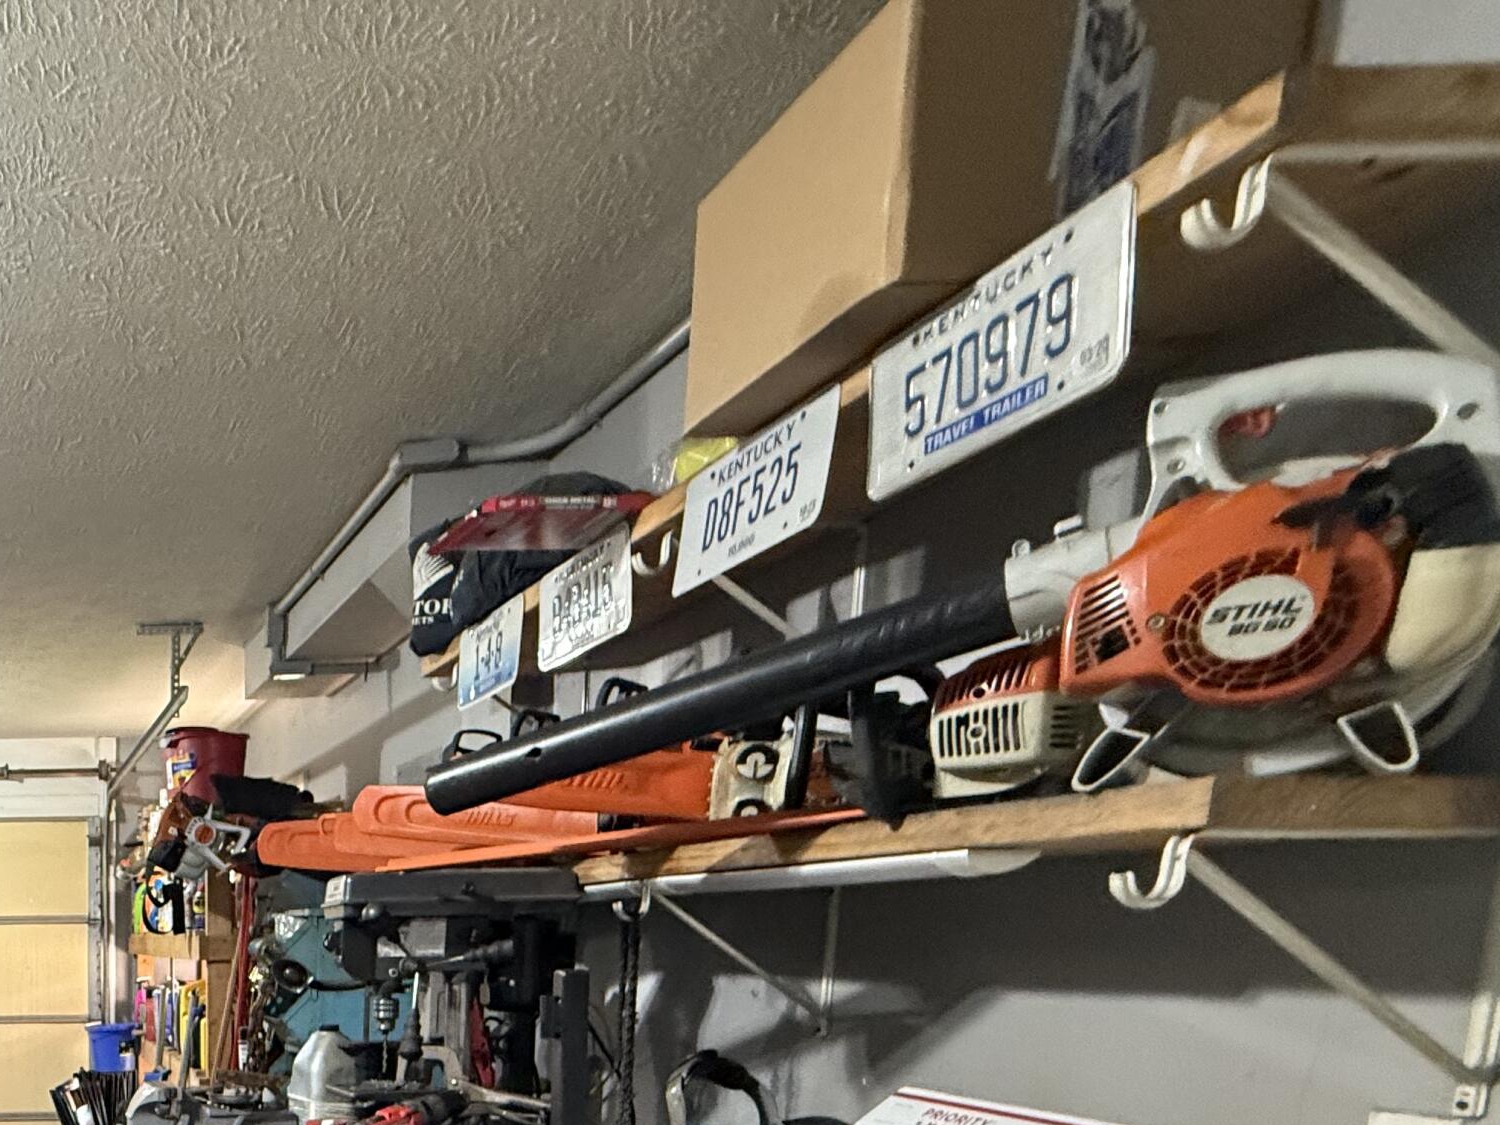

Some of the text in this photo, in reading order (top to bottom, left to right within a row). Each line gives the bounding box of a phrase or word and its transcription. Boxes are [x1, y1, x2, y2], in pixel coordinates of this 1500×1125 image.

[921, 243, 1054, 346] KENTUCKY
[904, 273, 1075, 437] 570979
[982, 379, 1047, 425] TRAILER
[717, 419, 797, 487] KENTUCKY
[702, 441, 803, 552] D8F525
[1206, 596, 1304, 625] STIHL
